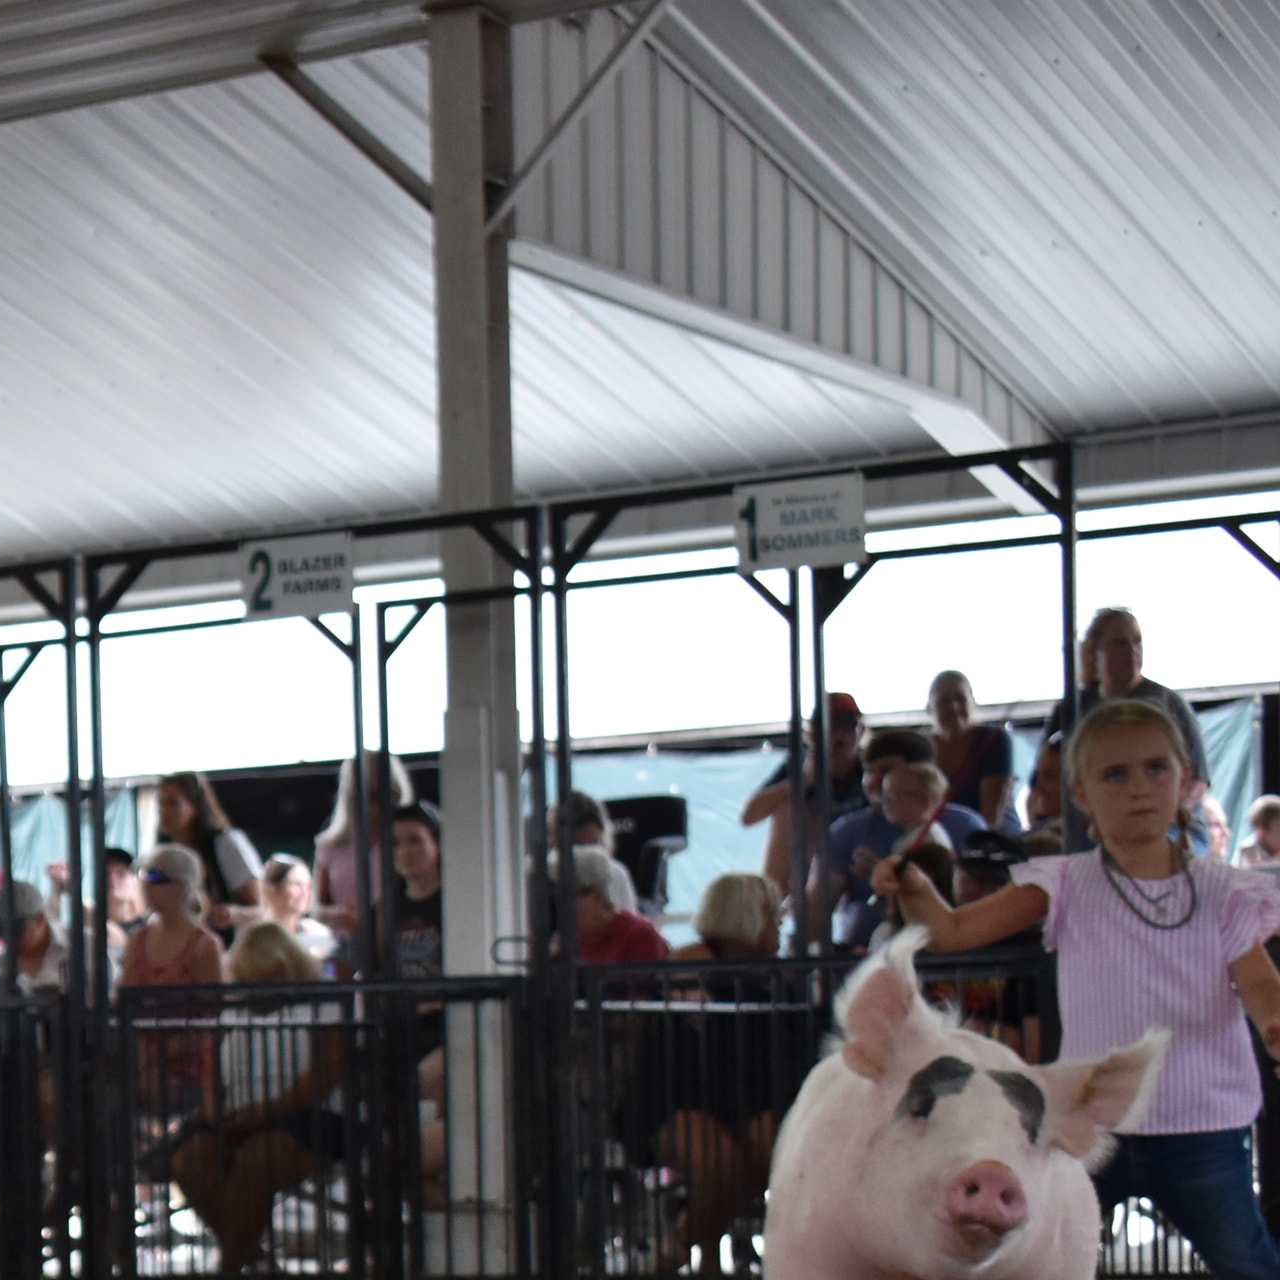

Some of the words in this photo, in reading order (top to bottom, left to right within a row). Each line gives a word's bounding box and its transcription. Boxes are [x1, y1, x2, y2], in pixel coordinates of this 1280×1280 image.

[781, 506, 838, 526] MARK
[740, 496, 758, 562] 1
[760, 528, 860, 553] SOMMERS
[278, 553, 346, 575] BLAZER
[249, 550, 273, 611] 2
[282, 577, 343, 595] FARMS
